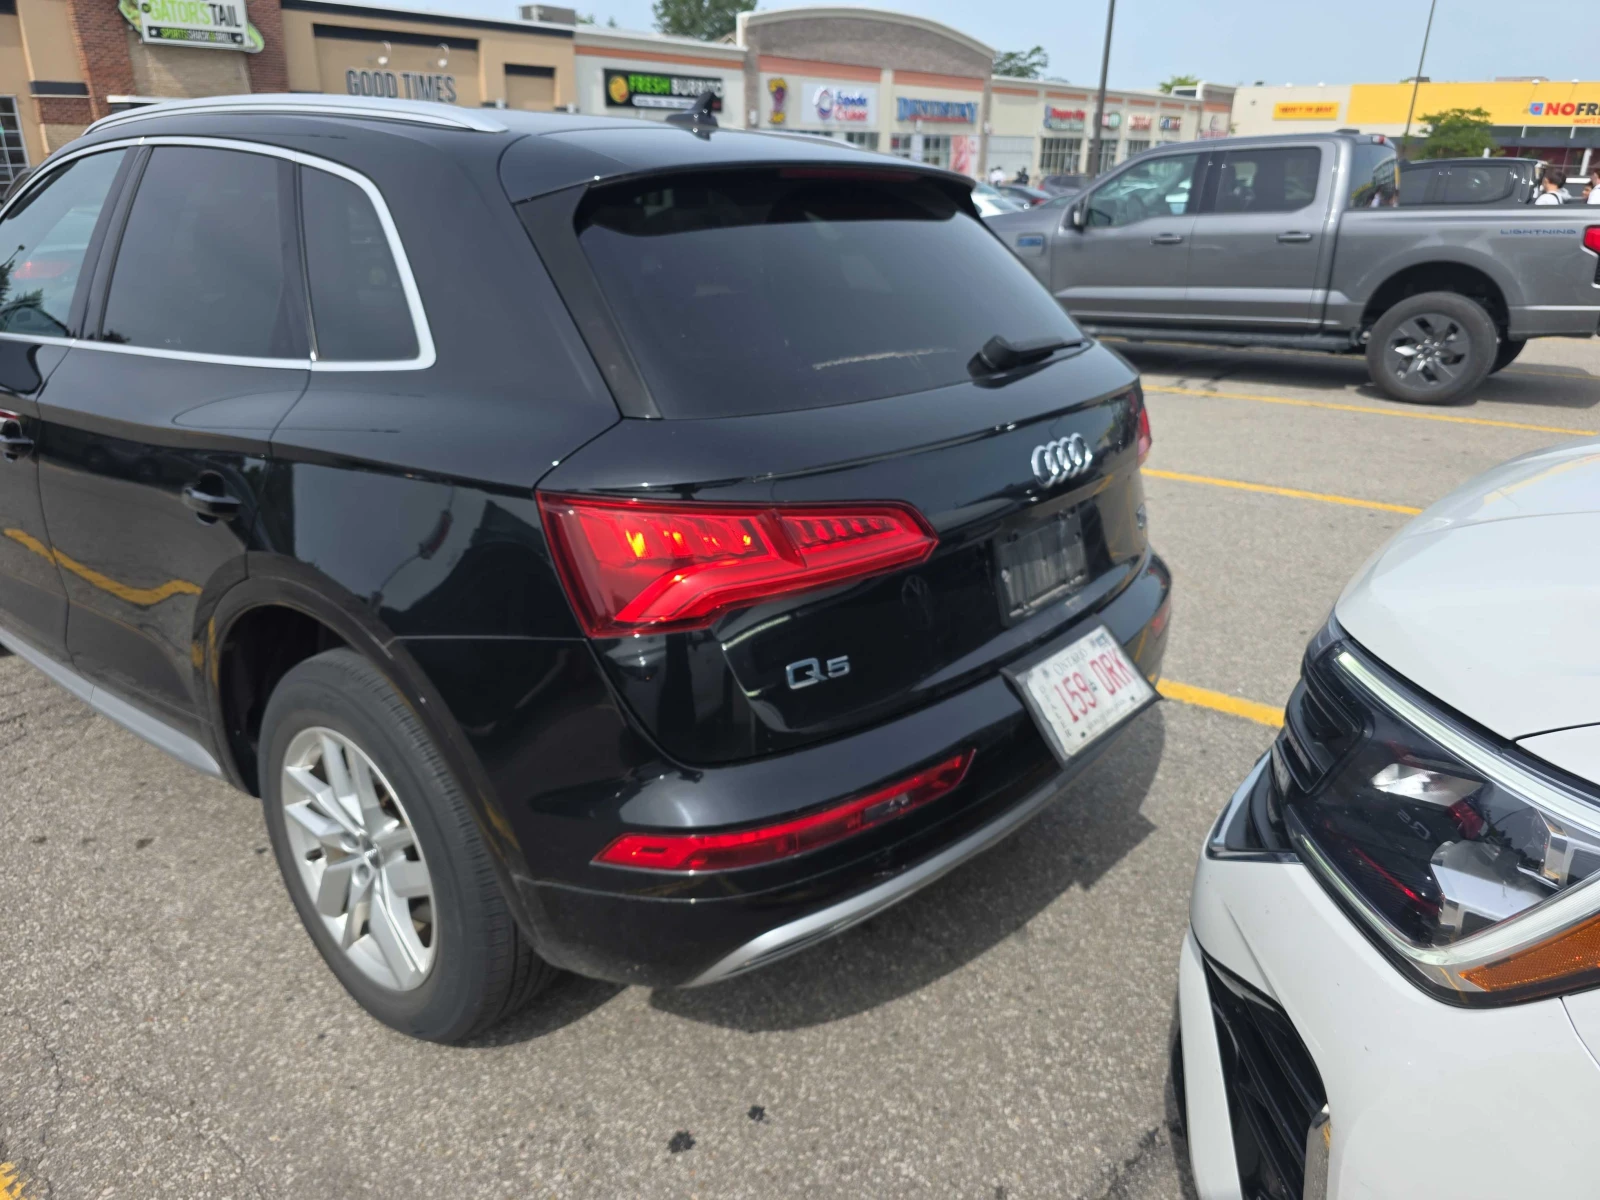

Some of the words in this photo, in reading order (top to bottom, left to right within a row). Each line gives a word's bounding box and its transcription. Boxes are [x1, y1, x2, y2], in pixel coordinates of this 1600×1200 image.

[208, 4, 242, 28] TAIL
[345, 69, 398, 98] GOOD
[401, 72, 457, 103] TIMES
[628, 74, 670, 94] FRESH
[785, 655, 850, 689] Q5
[1053, 671, 1097, 722] 159
[1089, 647, 1136, 695] DRK
